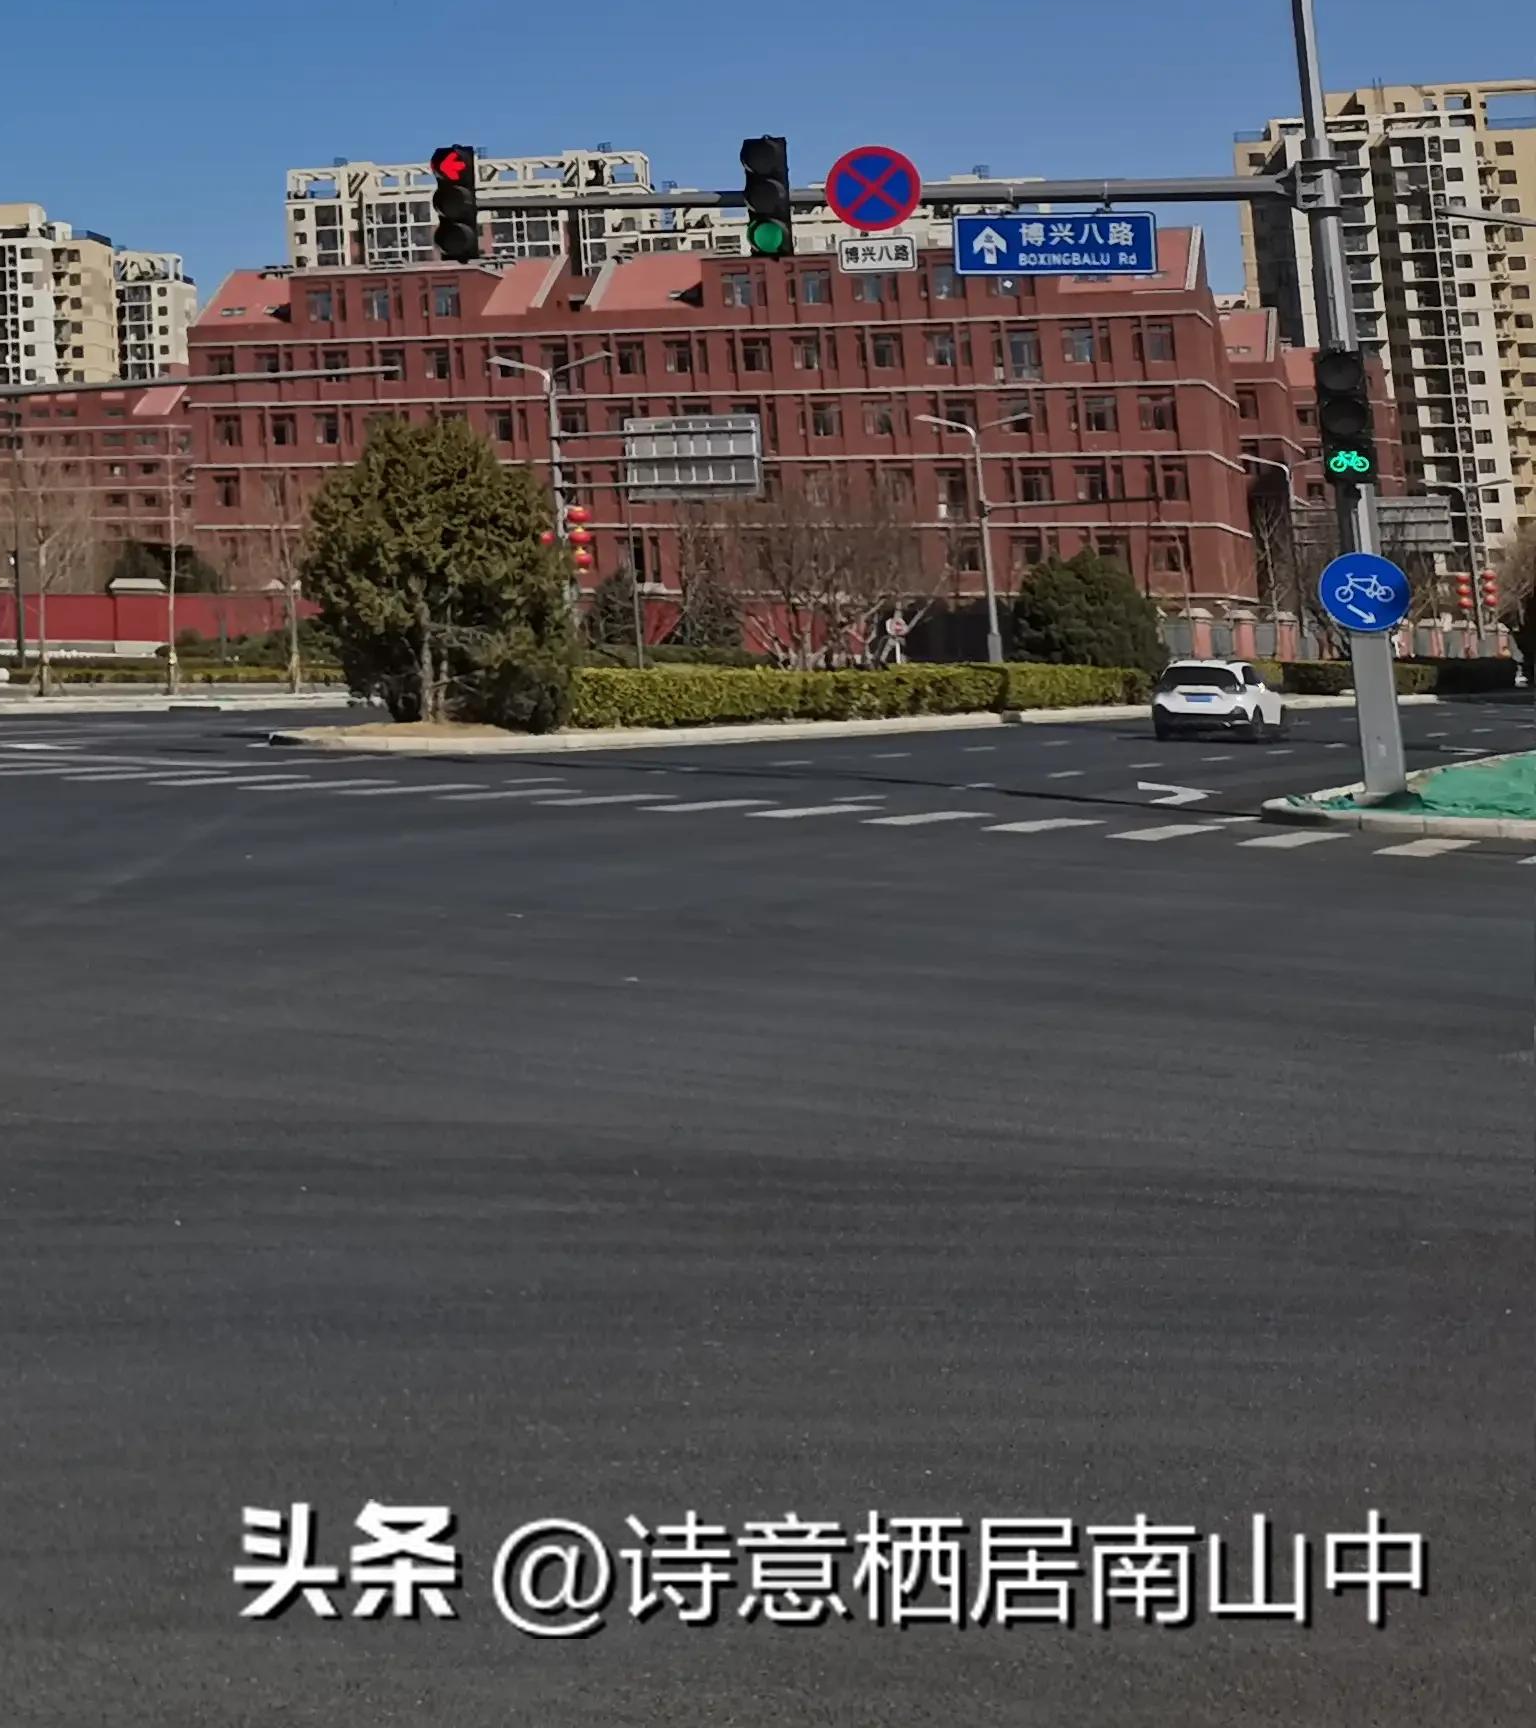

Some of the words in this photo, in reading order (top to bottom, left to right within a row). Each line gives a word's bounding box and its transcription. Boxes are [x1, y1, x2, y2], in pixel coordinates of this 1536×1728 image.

[1019, 222, 1134, 247] 博兴八路
[845, 244, 910, 264] 博兴八路
[1018, 252, 1110, 266] BOXINGBALU
[1118, 252, 1137, 265] Rd
